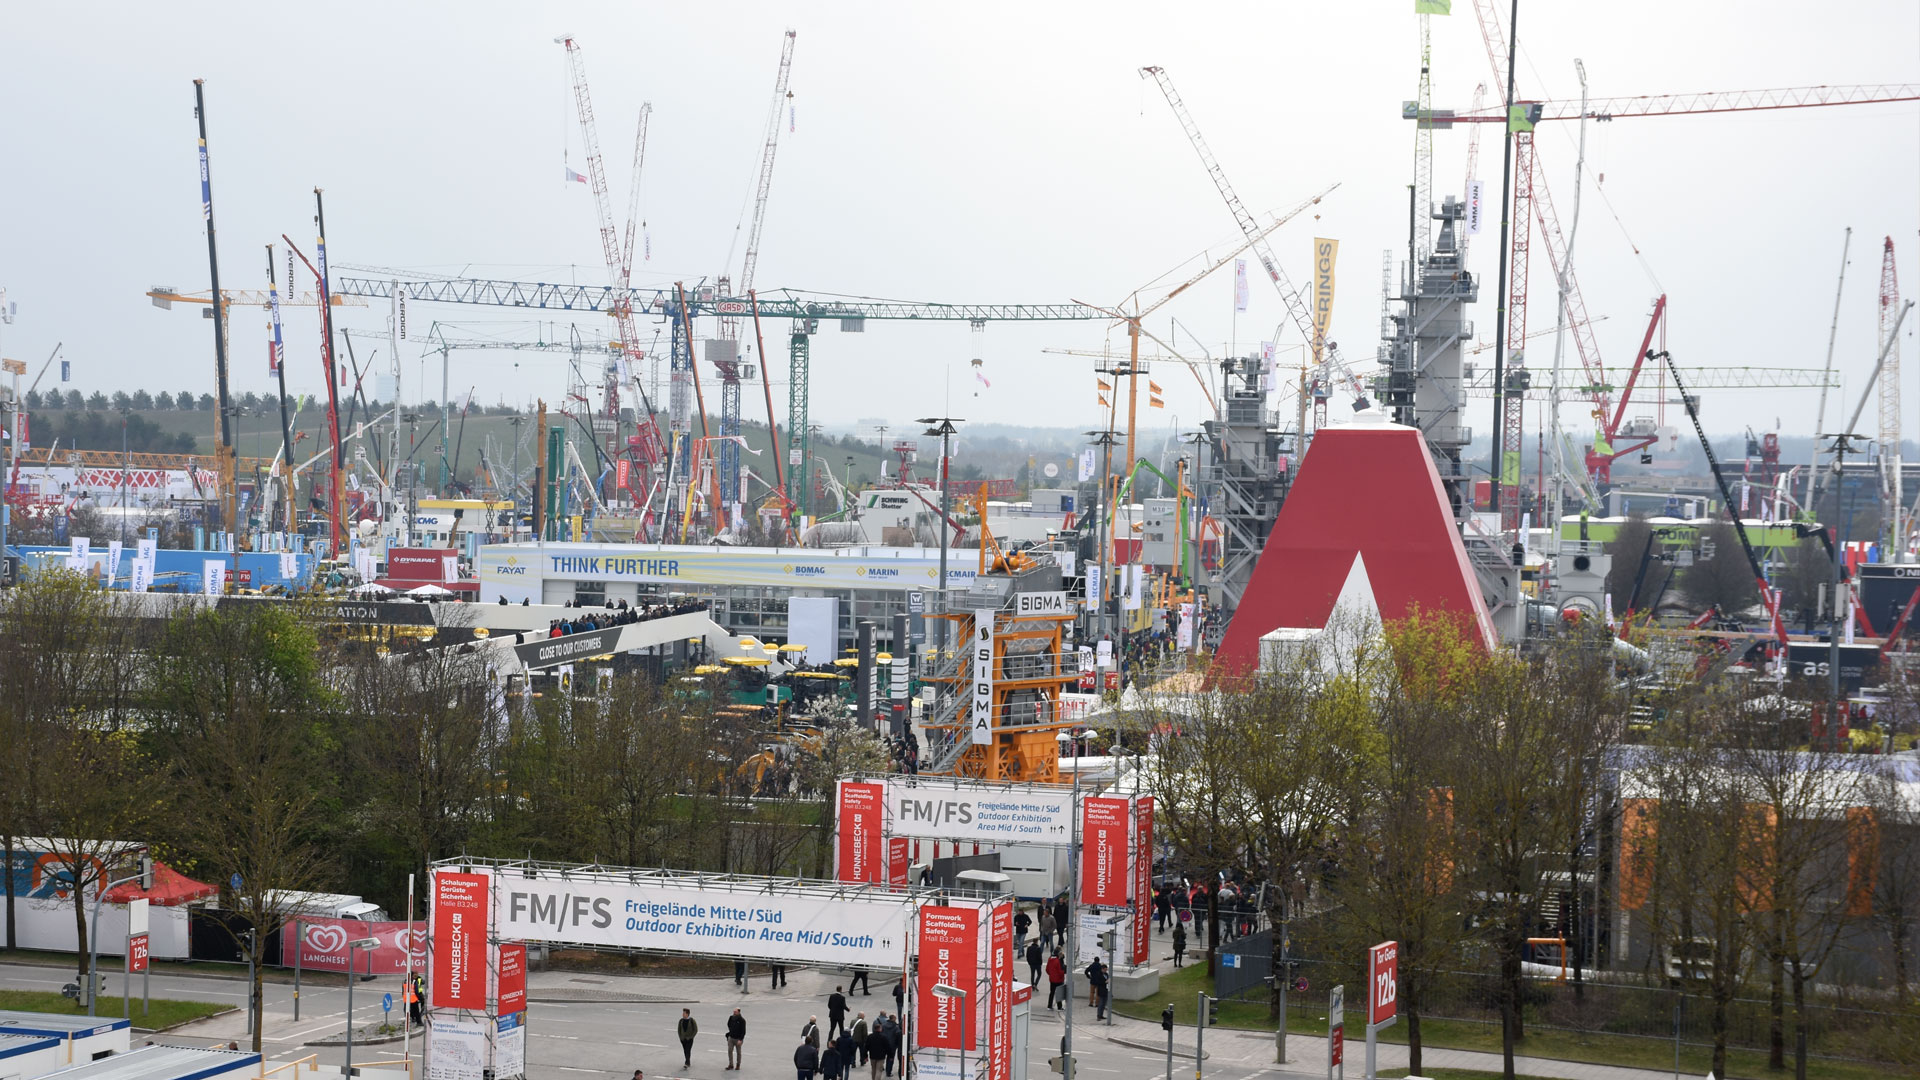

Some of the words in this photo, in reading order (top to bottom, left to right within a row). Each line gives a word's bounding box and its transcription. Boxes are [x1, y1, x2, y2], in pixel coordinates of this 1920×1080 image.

[1471, 185, 1479, 230] AMMANN
[398, 290, 407, 340] EVERDIGM
[415, 517, 439, 525] CMG
[497, 566, 526, 575] FAYAT
[551, 556, 600, 574] THINK
[605, 558, 680, 576] FURTHER
[795, 566, 825, 574] BOMAG
[869, 568, 899, 576] MARINI
[943, 570, 976, 579] ECMAIR
[1021, 595, 1063, 612] SIGMA
[539, 646, 556, 660] CLOSE
[555, 644, 563, 656] TO
[562, 642, 574, 655] OUR
[573, 636, 602, 653] CUSTOMERS
[976, 648, 991, 731] SIGMA
[977, 801, 1020, 812] Freigelände
[1021, 804, 1040, 813] Mitte
[1046, 804, 1060, 814] Süd
[1087, 802, 1120, 810] Schalungen
[900, 799, 973, 828] FM/FS
[977, 812, 1010, 821] Outdoor
[1011, 813, 1052, 823] Exhibition
[977, 822, 996, 831] Area
[997, 823, 1012, 832] Mid
[1018, 824, 1042, 834] South
[440, 879, 479, 888] Schalungen
[440, 886, 466, 894] Gerüste
[440, 893, 473, 901] Sicherheit
[457, 900, 479, 909] B3.248
[625, 899, 706, 918] Freigelände
[509, 892, 612, 933] FM/FS
[925, 912, 962, 922] Formwork
[625, 917, 682, 934] Outdoor
[685, 921, 757, 940] Exhibition
[760, 927, 793, 943] Area
[925, 920, 966, 931] Scaffolding
[925, 927, 948, 936] Safety
[137, 937, 148, 945] Gate
[925, 935, 938, 943] Hall
[939, 936, 963, 944] B3.248
[134, 946, 148, 959] 12b
[1384, 948, 1396, 962] Gate
[303, 953, 346, 965] LANGNESE
[451, 924, 463, 999] HÜNNEBECK
[1377, 967, 1396, 1008] 12b
[937, 961, 949, 1039] HÜNNEECK
